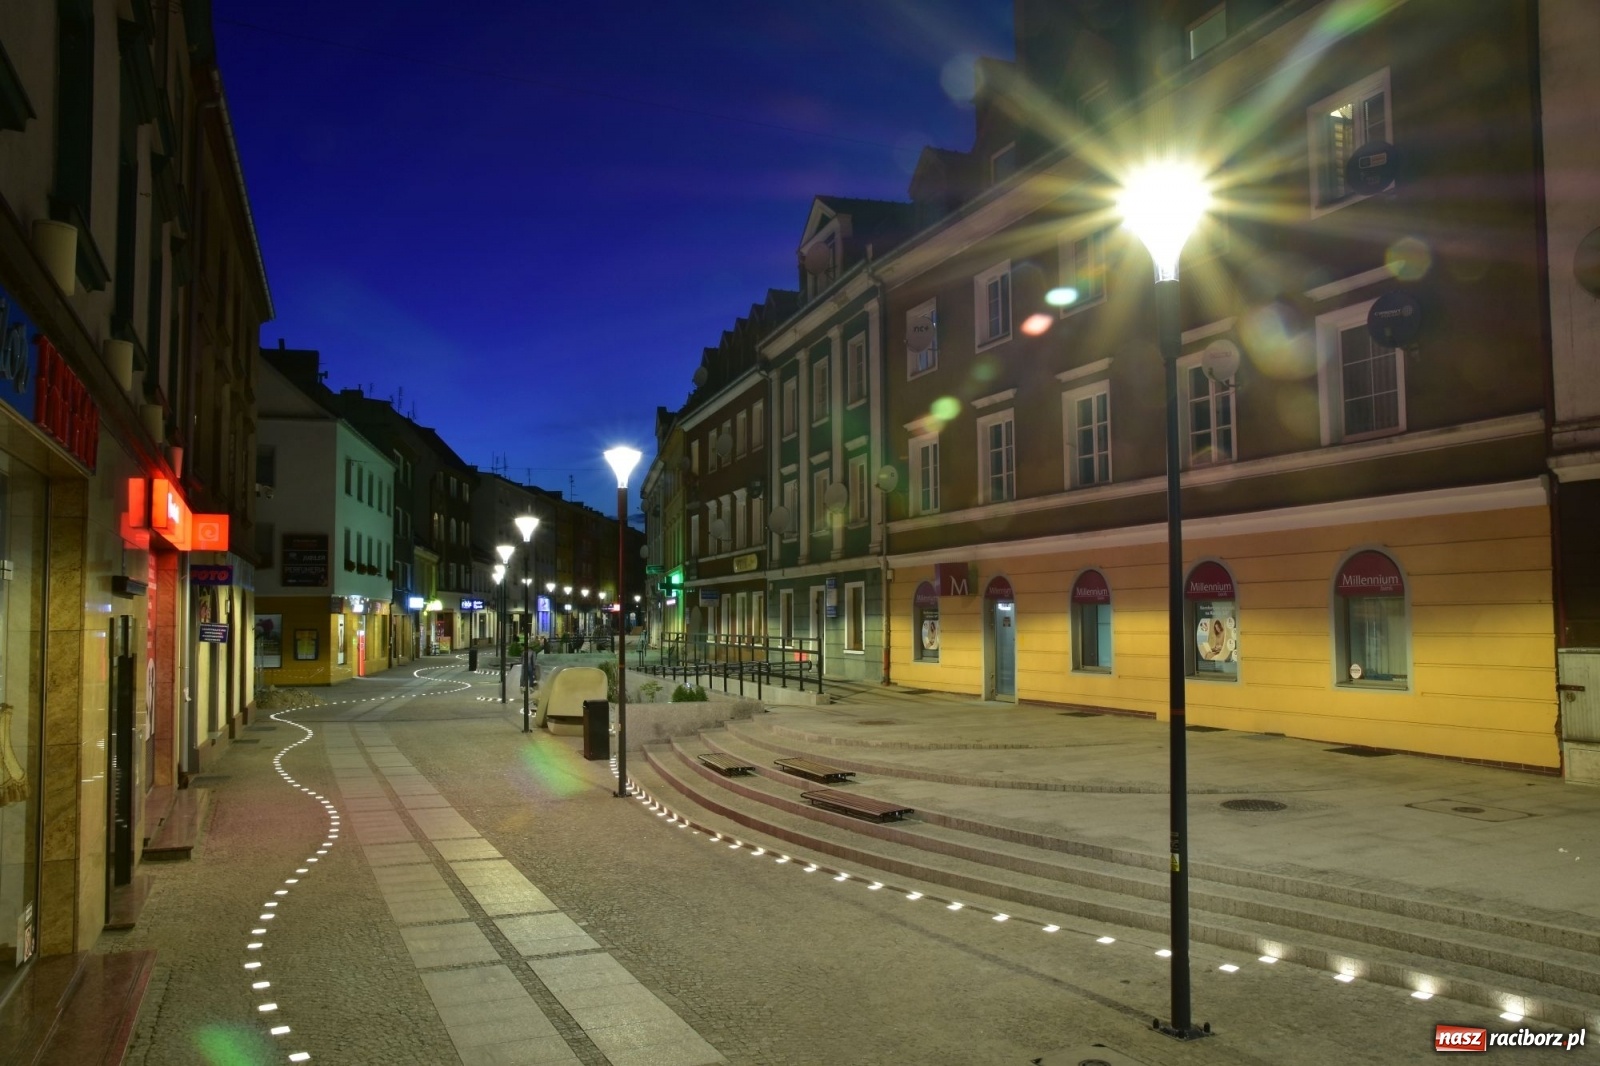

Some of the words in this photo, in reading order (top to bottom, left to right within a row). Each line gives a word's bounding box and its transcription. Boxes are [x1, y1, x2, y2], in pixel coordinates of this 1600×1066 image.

[913, 325, 929, 333] nc+
[1342, 574, 1399, 586] Millennium
[950, 575, 969, 597] M
[1190, 581, 1232, 592] Millennium
[1076, 587, 1108, 597] Millennium
